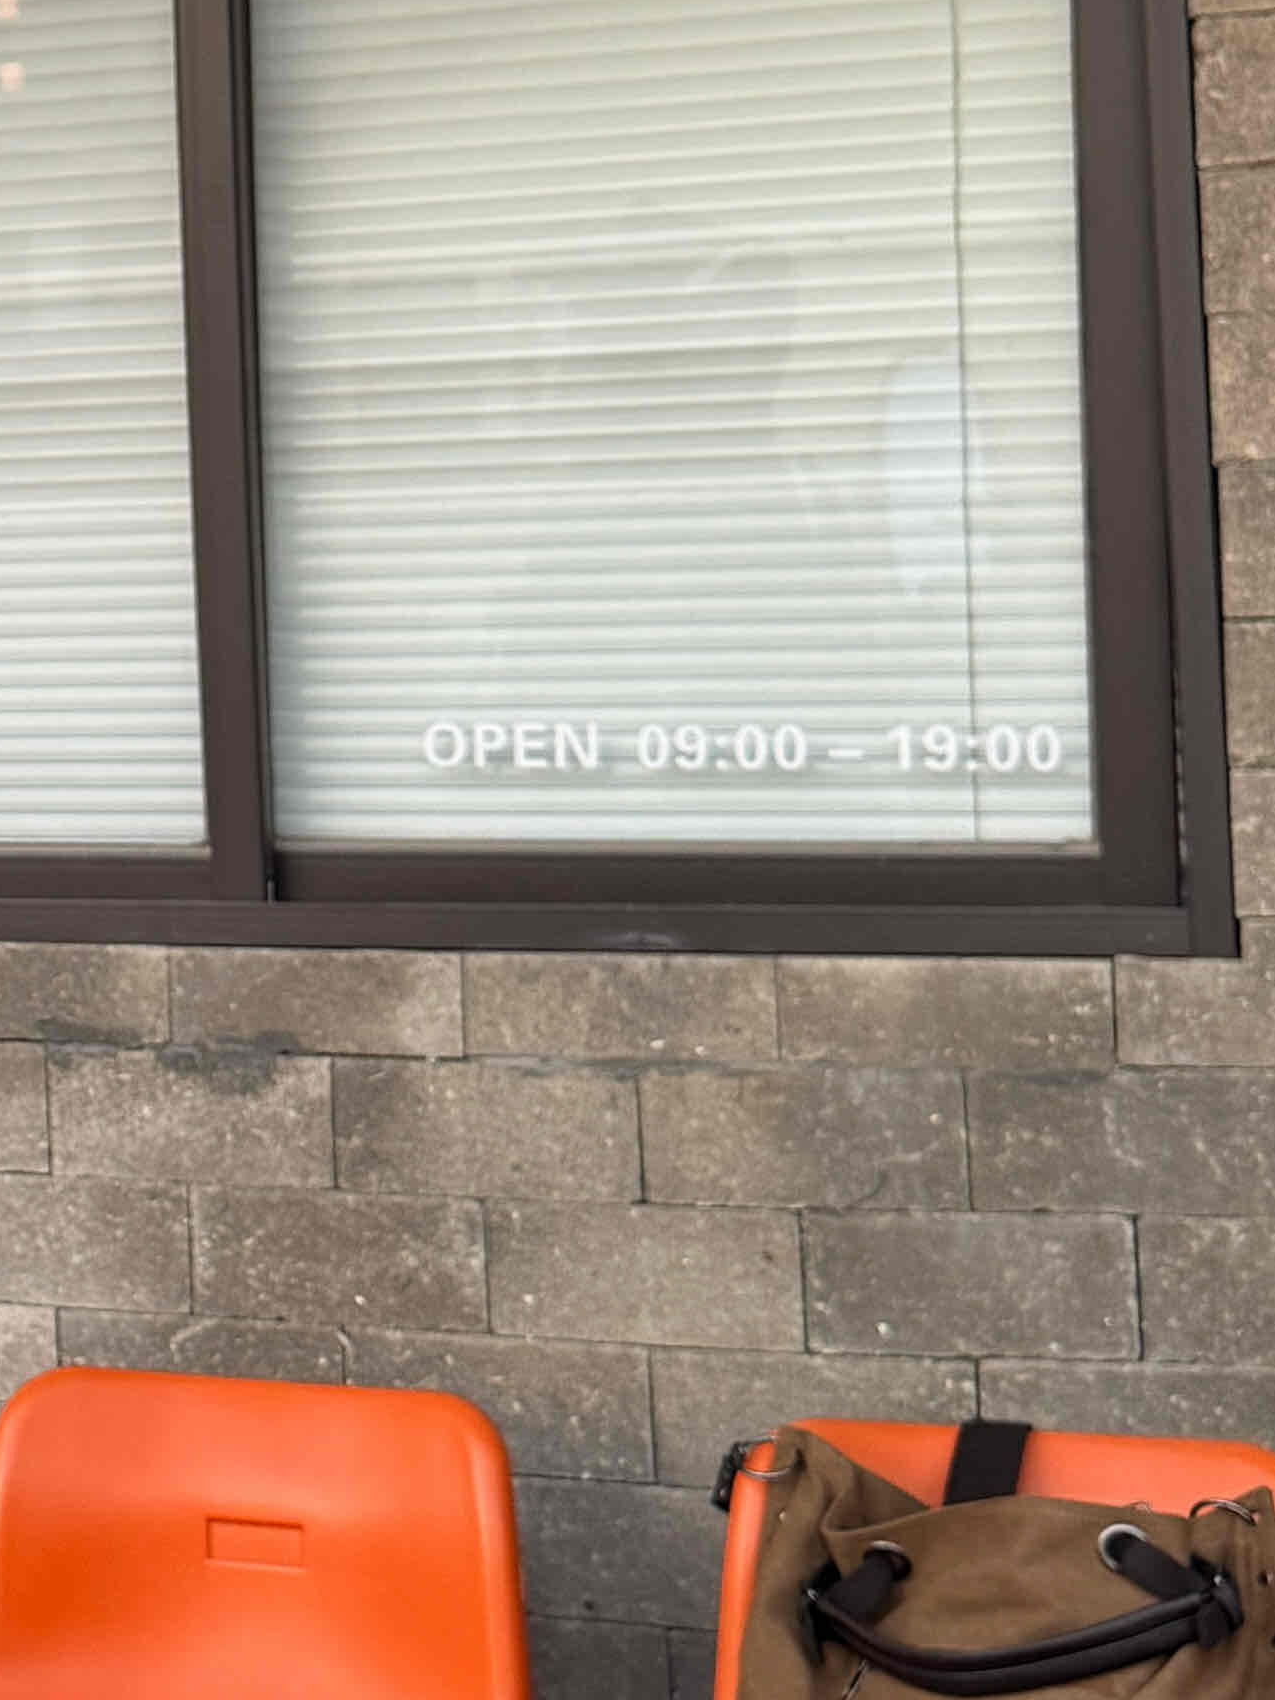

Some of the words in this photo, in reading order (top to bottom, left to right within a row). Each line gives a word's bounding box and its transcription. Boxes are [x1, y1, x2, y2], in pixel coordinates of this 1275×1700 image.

[422, 723, 600, 770] OPEN
[636, 724, 808, 771] 09:00
[886, 724, 1062, 772] 19:00
